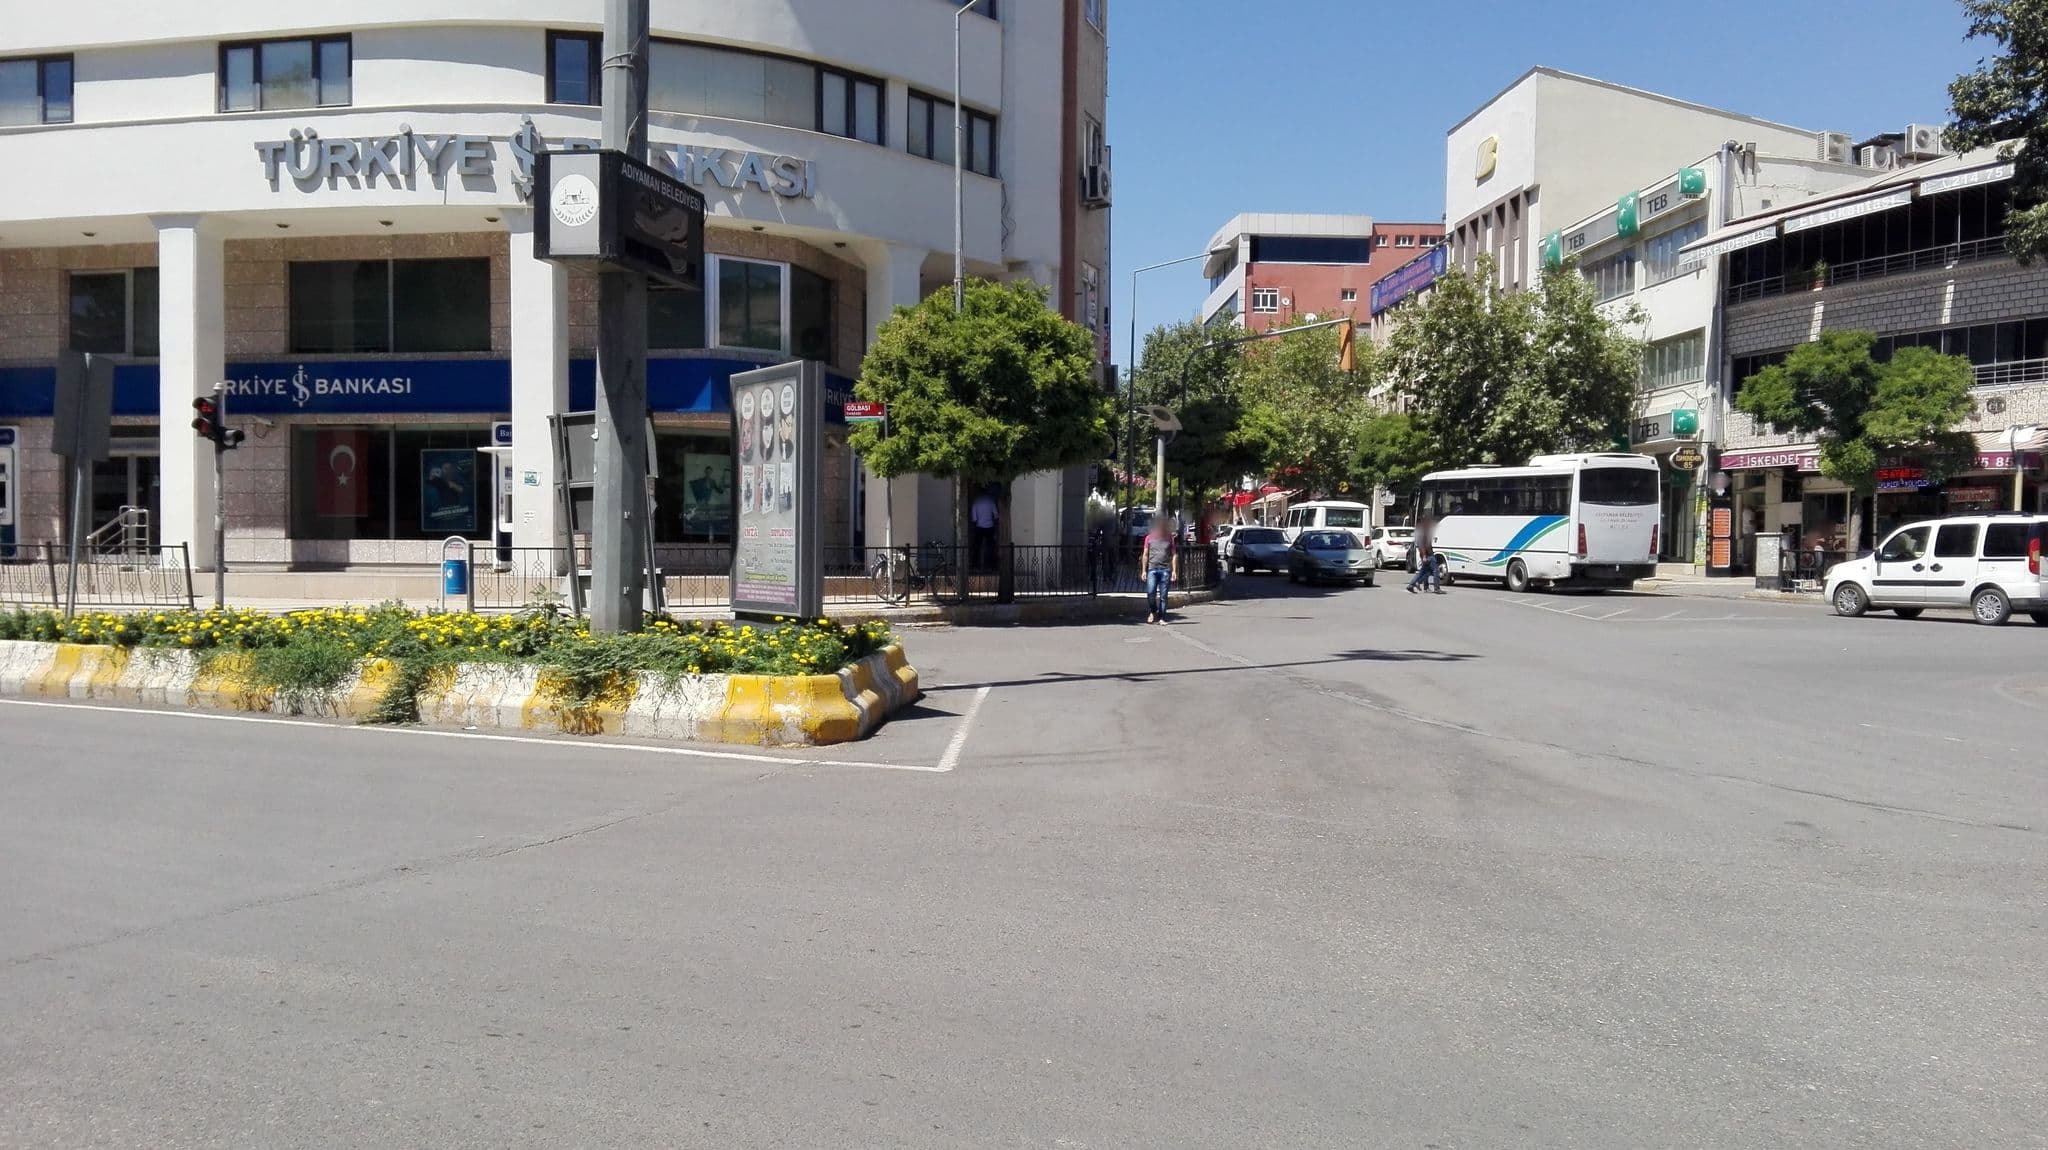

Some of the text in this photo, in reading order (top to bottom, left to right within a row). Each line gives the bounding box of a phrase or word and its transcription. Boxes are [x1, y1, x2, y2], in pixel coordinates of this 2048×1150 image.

[254, 122, 490, 179] TÜRKİYE
[621, 162, 660, 193] ADIYAMAN
[1647, 193, 1668, 214] TEB
[1568, 232, 1585, 250] TEB
[225, 375, 287, 395] RKİYE
[315, 377, 411, 394] BANKASI
[1640, 422, 1660, 438] TEB
[1682, 461, 1694, 469] 85
[1996, 456, 2015, 467] 85
